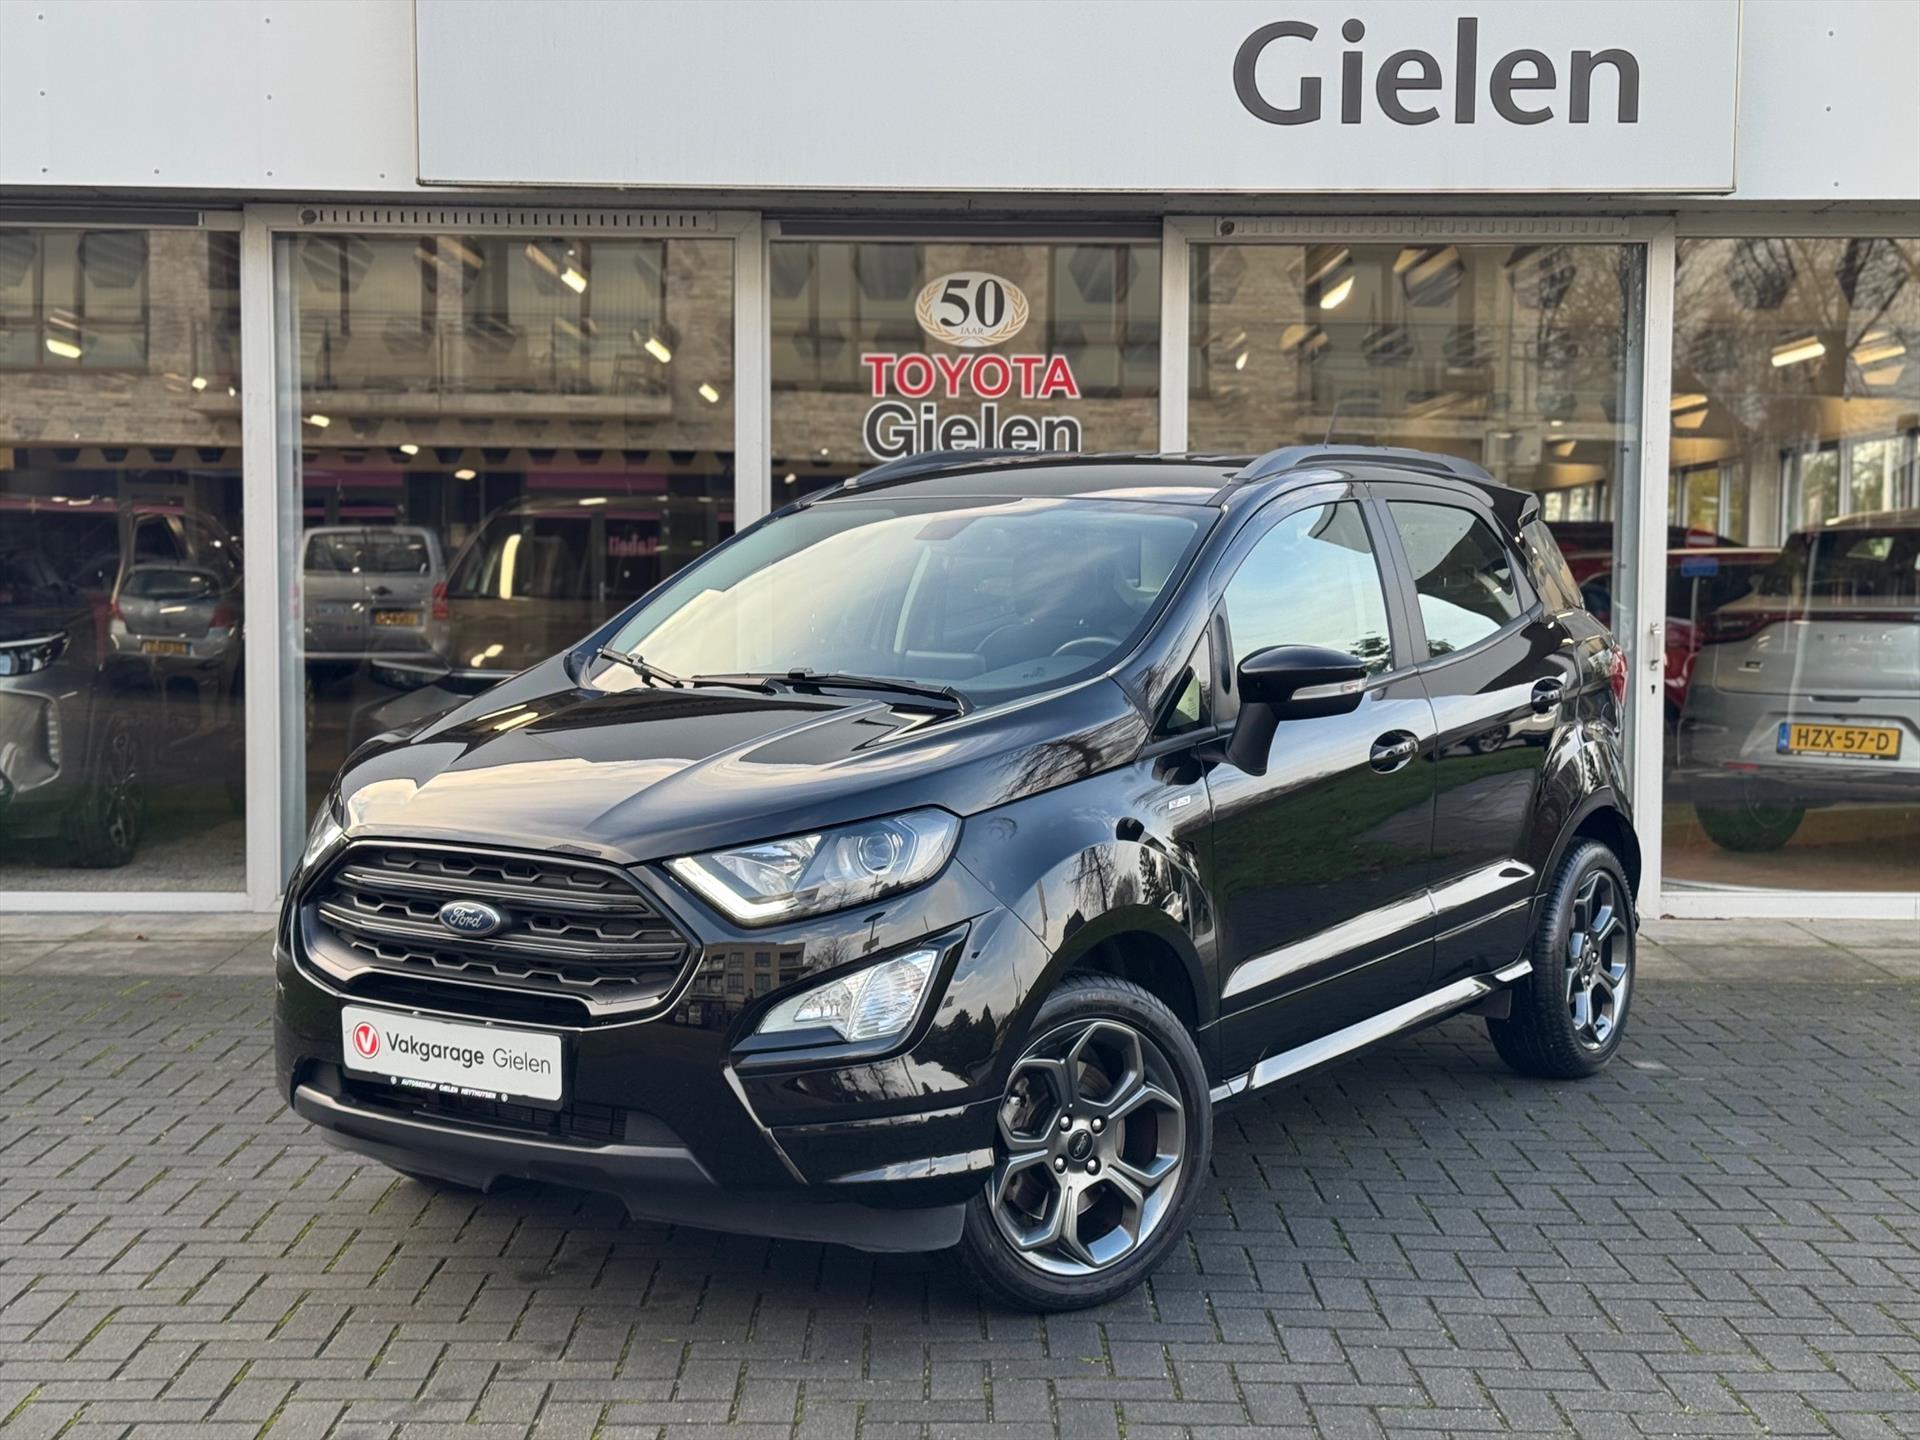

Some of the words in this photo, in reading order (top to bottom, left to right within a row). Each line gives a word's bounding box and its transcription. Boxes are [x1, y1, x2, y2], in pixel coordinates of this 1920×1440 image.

[1233, 17, 1640, 126] Gielen
[939, 279, 1006, 328] 50
[959, 327, 985, 336] JAAR
[862, 355, 1080, 399] TOYOTA
[863, 401, 1081, 461] Gielen
[1796, 728, 1890, 751] HZX-57-D
[449, 906, 484, 928] Ford
[386, 1032, 485, 1069] Vakgarage
[493, 1047, 552, 1075] Gielen
